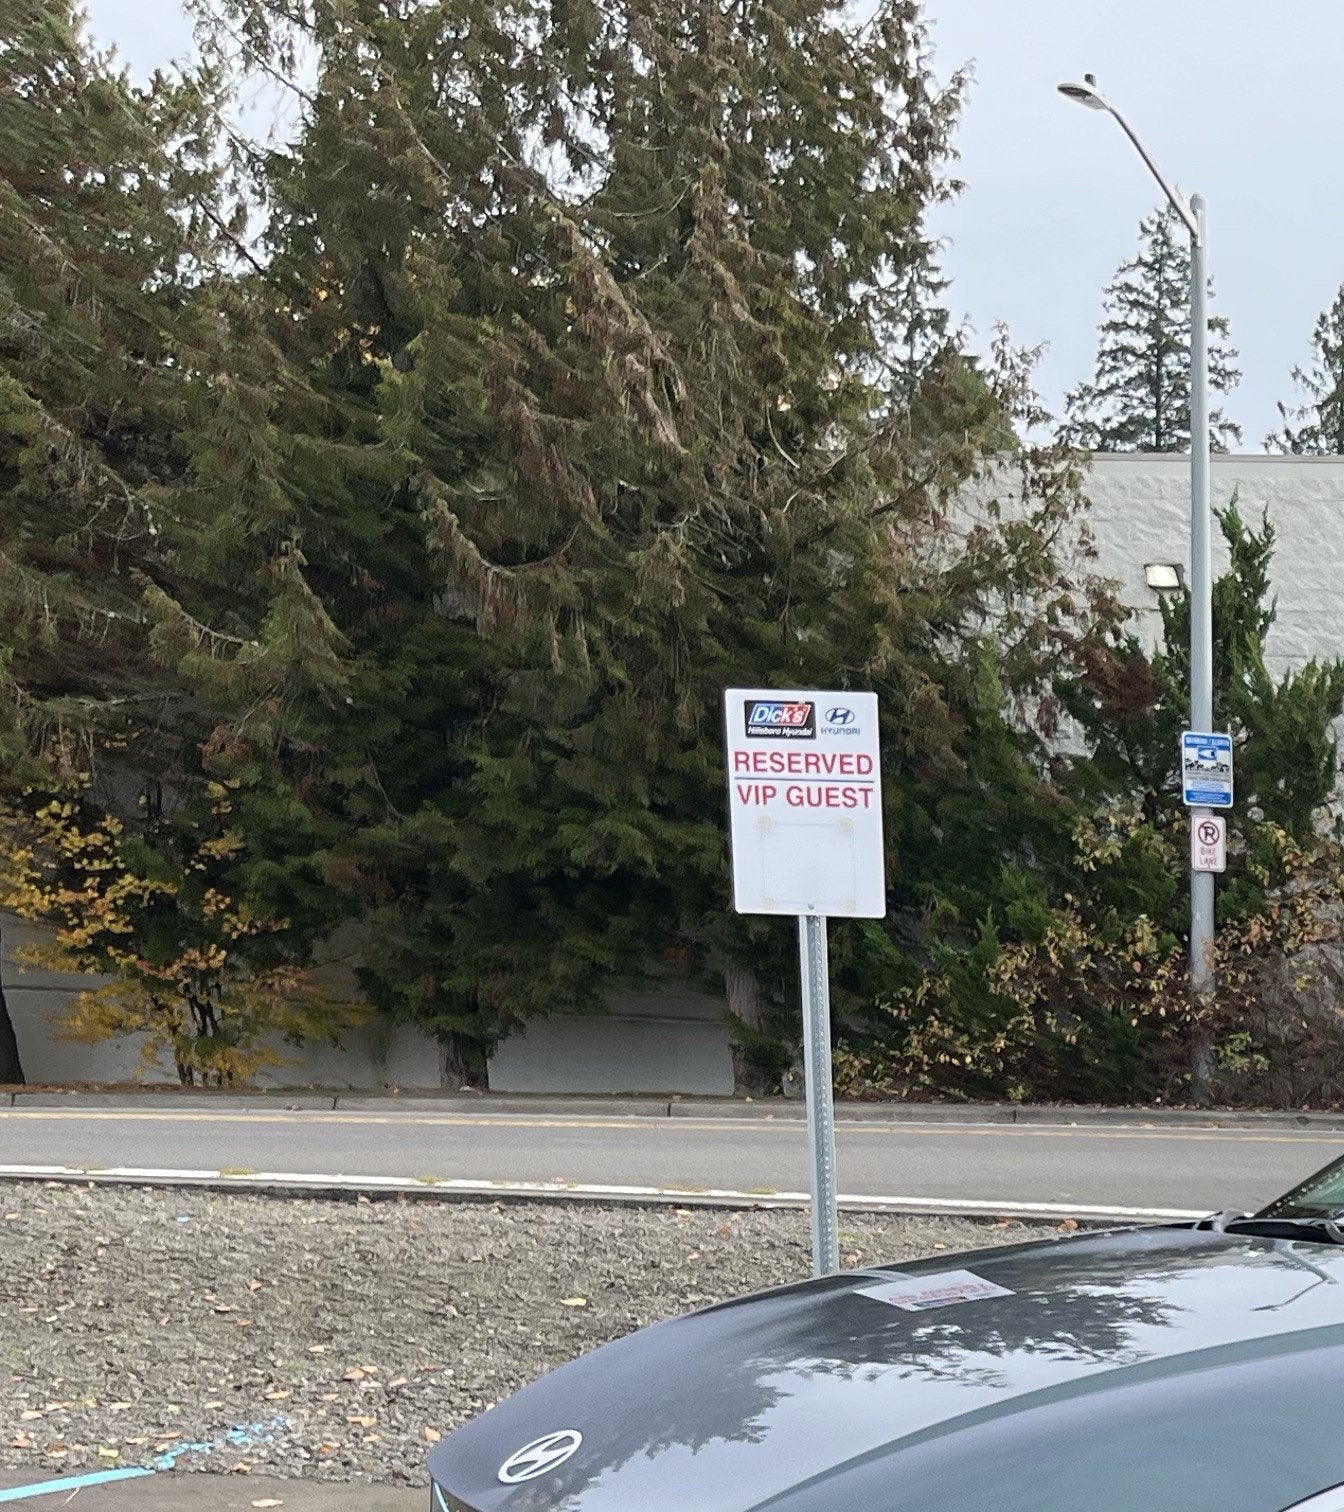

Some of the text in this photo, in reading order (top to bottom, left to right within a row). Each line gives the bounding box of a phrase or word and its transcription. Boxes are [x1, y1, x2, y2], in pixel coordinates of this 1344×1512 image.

[734, 751, 873, 775] RESERVED
[738, 785, 873, 808] VIP GUEST
